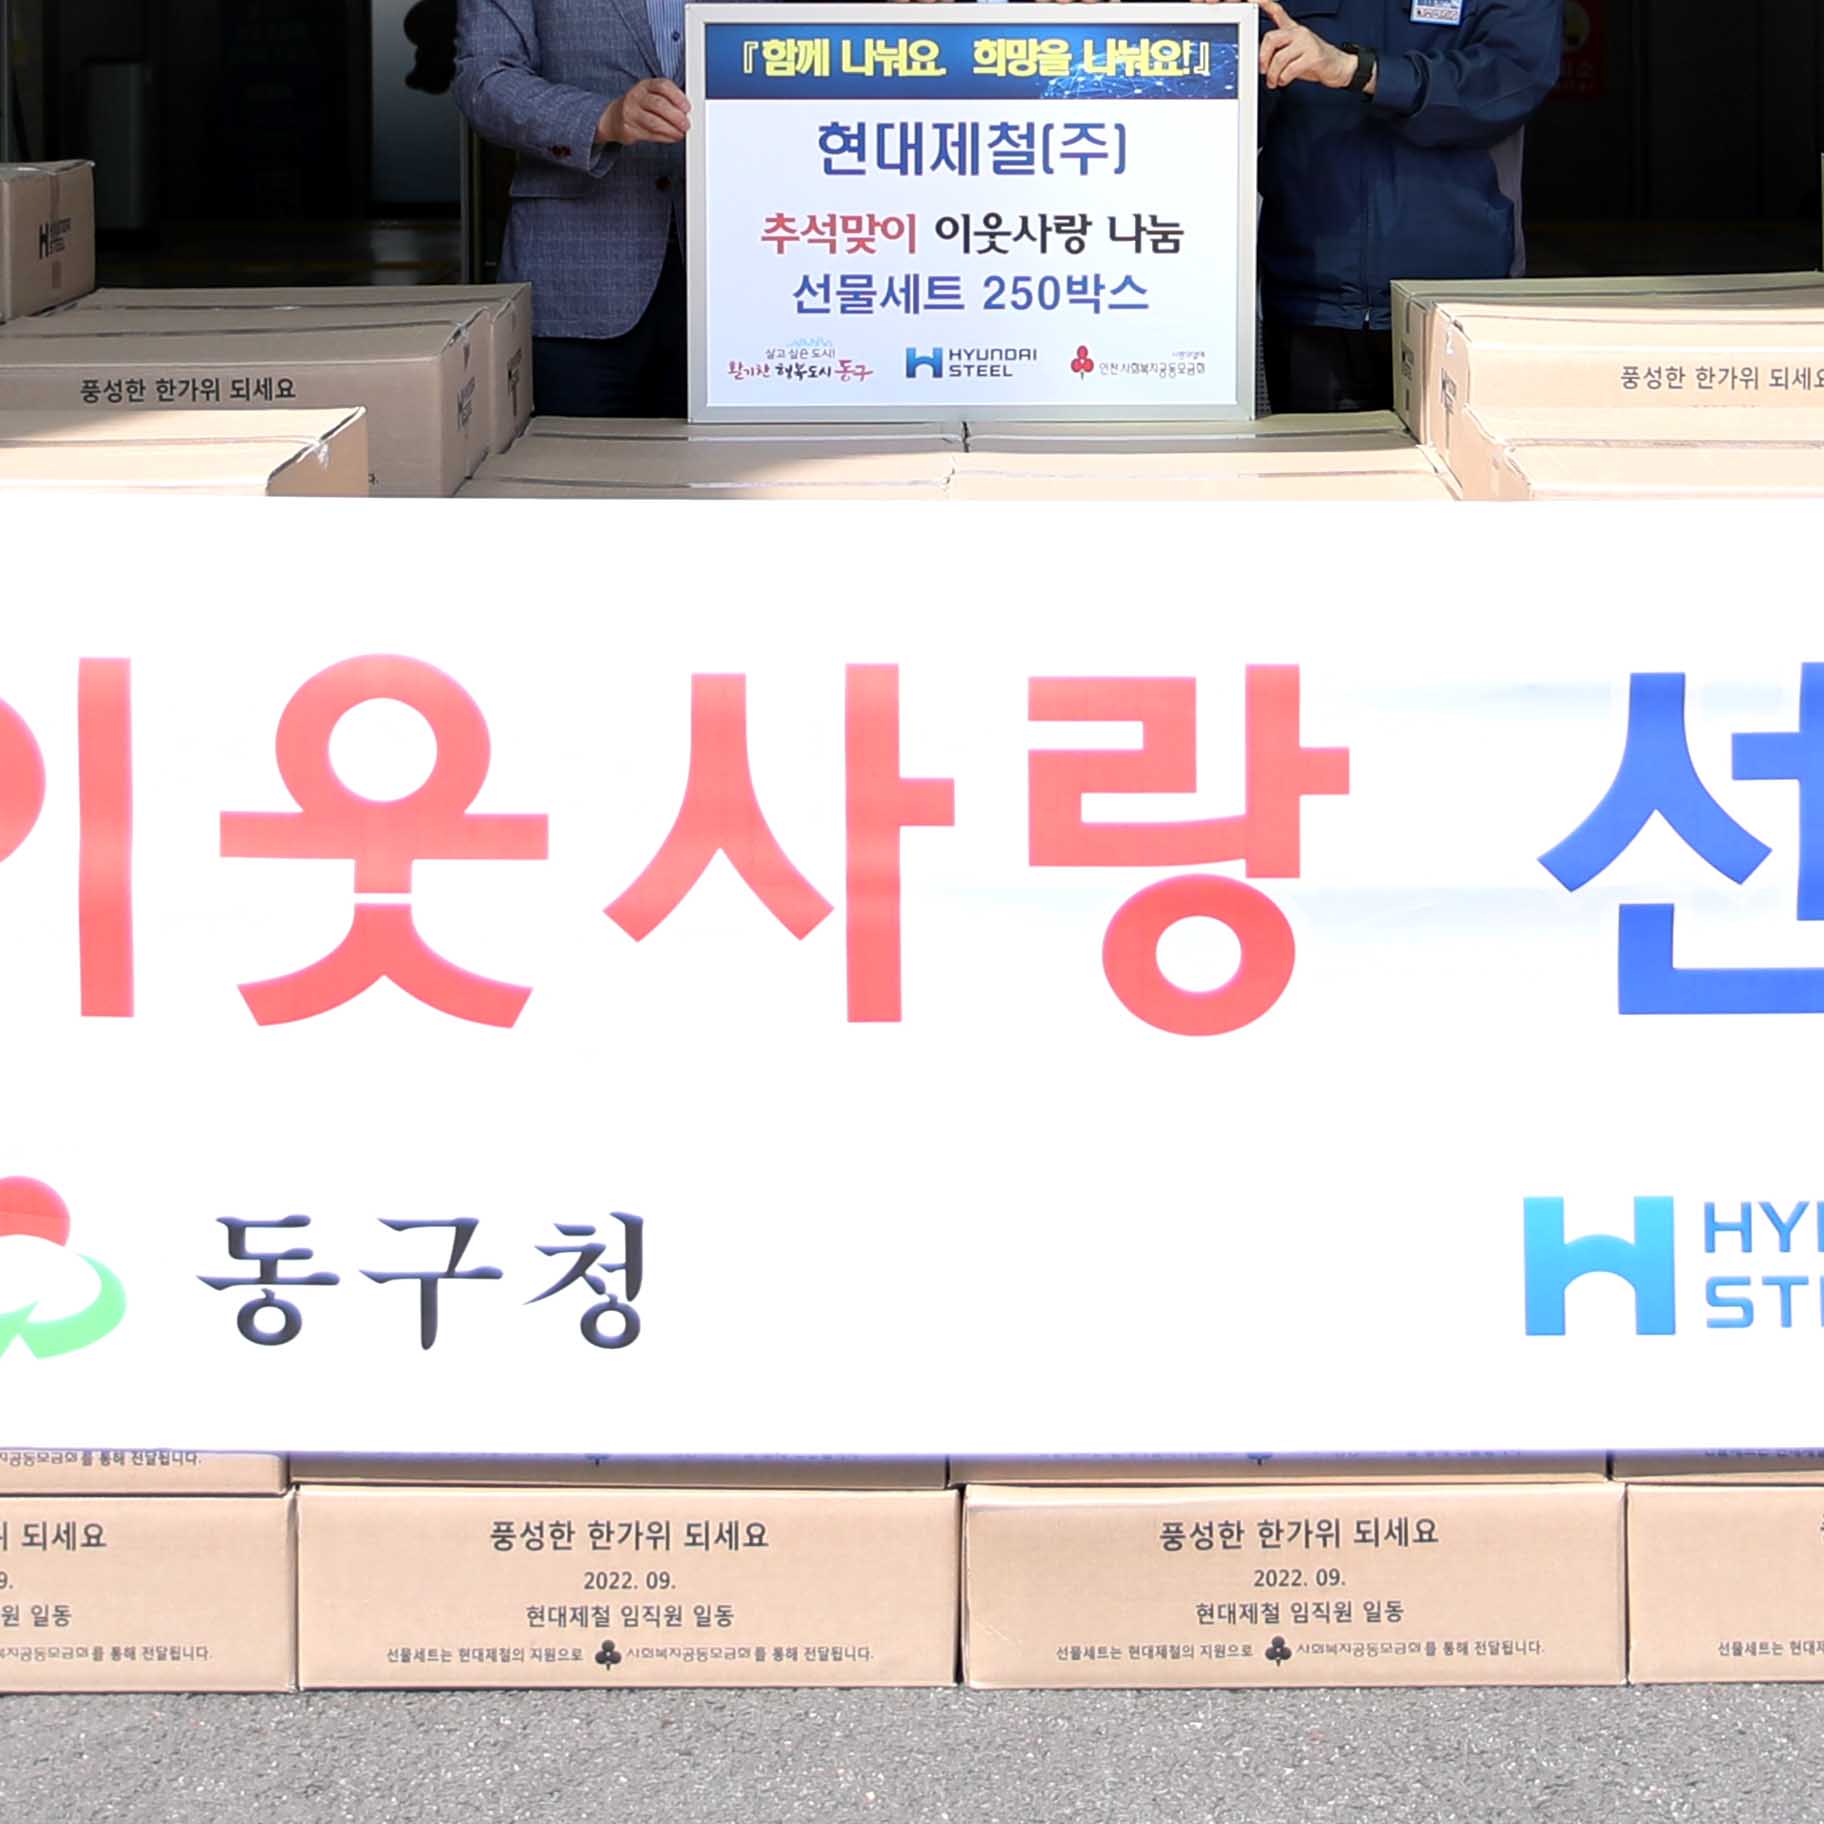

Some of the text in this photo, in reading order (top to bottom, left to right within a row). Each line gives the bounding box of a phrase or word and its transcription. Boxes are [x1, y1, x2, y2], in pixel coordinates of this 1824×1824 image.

[973, 38, 1072, 77] 희망을
[817, 121, 1127, 176] 현대제철(주)
[761, 212, 1185, 255] 추석맞이 이웃사랑 나눔
[793, 273, 1150, 315] 선물세트 250박스
[949, 348, 1037, 361] HYUNDAI
[834, 359, 874, 382] 동구
[949, 364, 1013, 377] STEEL
[1621, 366, 1686, 390] 풍성한
[1696, 366, 1758, 390] 한가위
[80, 377, 296, 403] 풍성한 한가위 되세요
[198, 1212, 648, 1352] 동구청
[1160, 1517, 1438, 1551] 풍성한 한가위 되세요
[1254, 1568, 1345, 1587] 2022. 09.
[1196, 1600, 1404, 1625] 현대제철 임직원 일동
